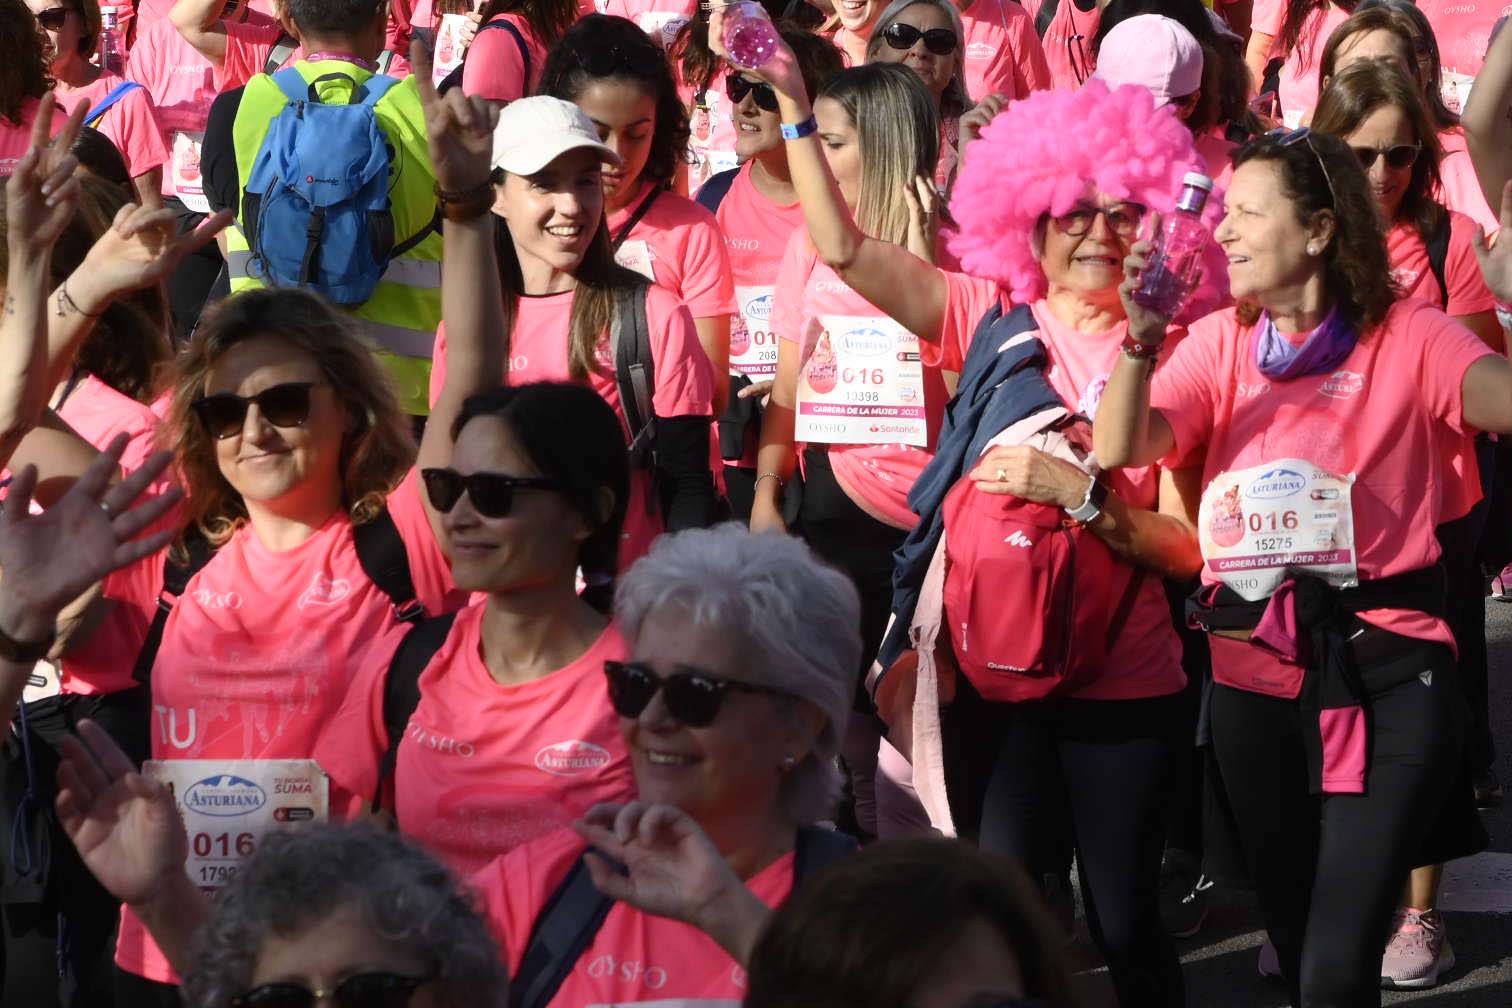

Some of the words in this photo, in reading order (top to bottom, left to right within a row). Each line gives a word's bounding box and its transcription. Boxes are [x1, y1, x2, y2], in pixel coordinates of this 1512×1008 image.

[759, 351, 777, 361] 208
[813, 405, 845, 415] CARRERA
[847, 406, 858, 415] DE
[859, 407, 869, 415] LA
[871, 407, 898, 416] MUJER
[1251, 480, 1303, 496] ASTURIANA
[1249, 511, 1299, 533] 016
[1255, 537, 1293, 552] 15275
[1219, 558, 1257, 571] CARRERA
[1257, 558, 1270, 568] DE
[1271, 557, 1282, 566] LA
[1281, 553, 1315, 566] MUJER
[155, 704, 197, 751] TU
[540, 753, 606, 770] ASTURIANA
[275, 784, 313, 795] SUMA
[190, 791, 260, 807] ASTURIANA
[193, 832, 256, 858] 016
